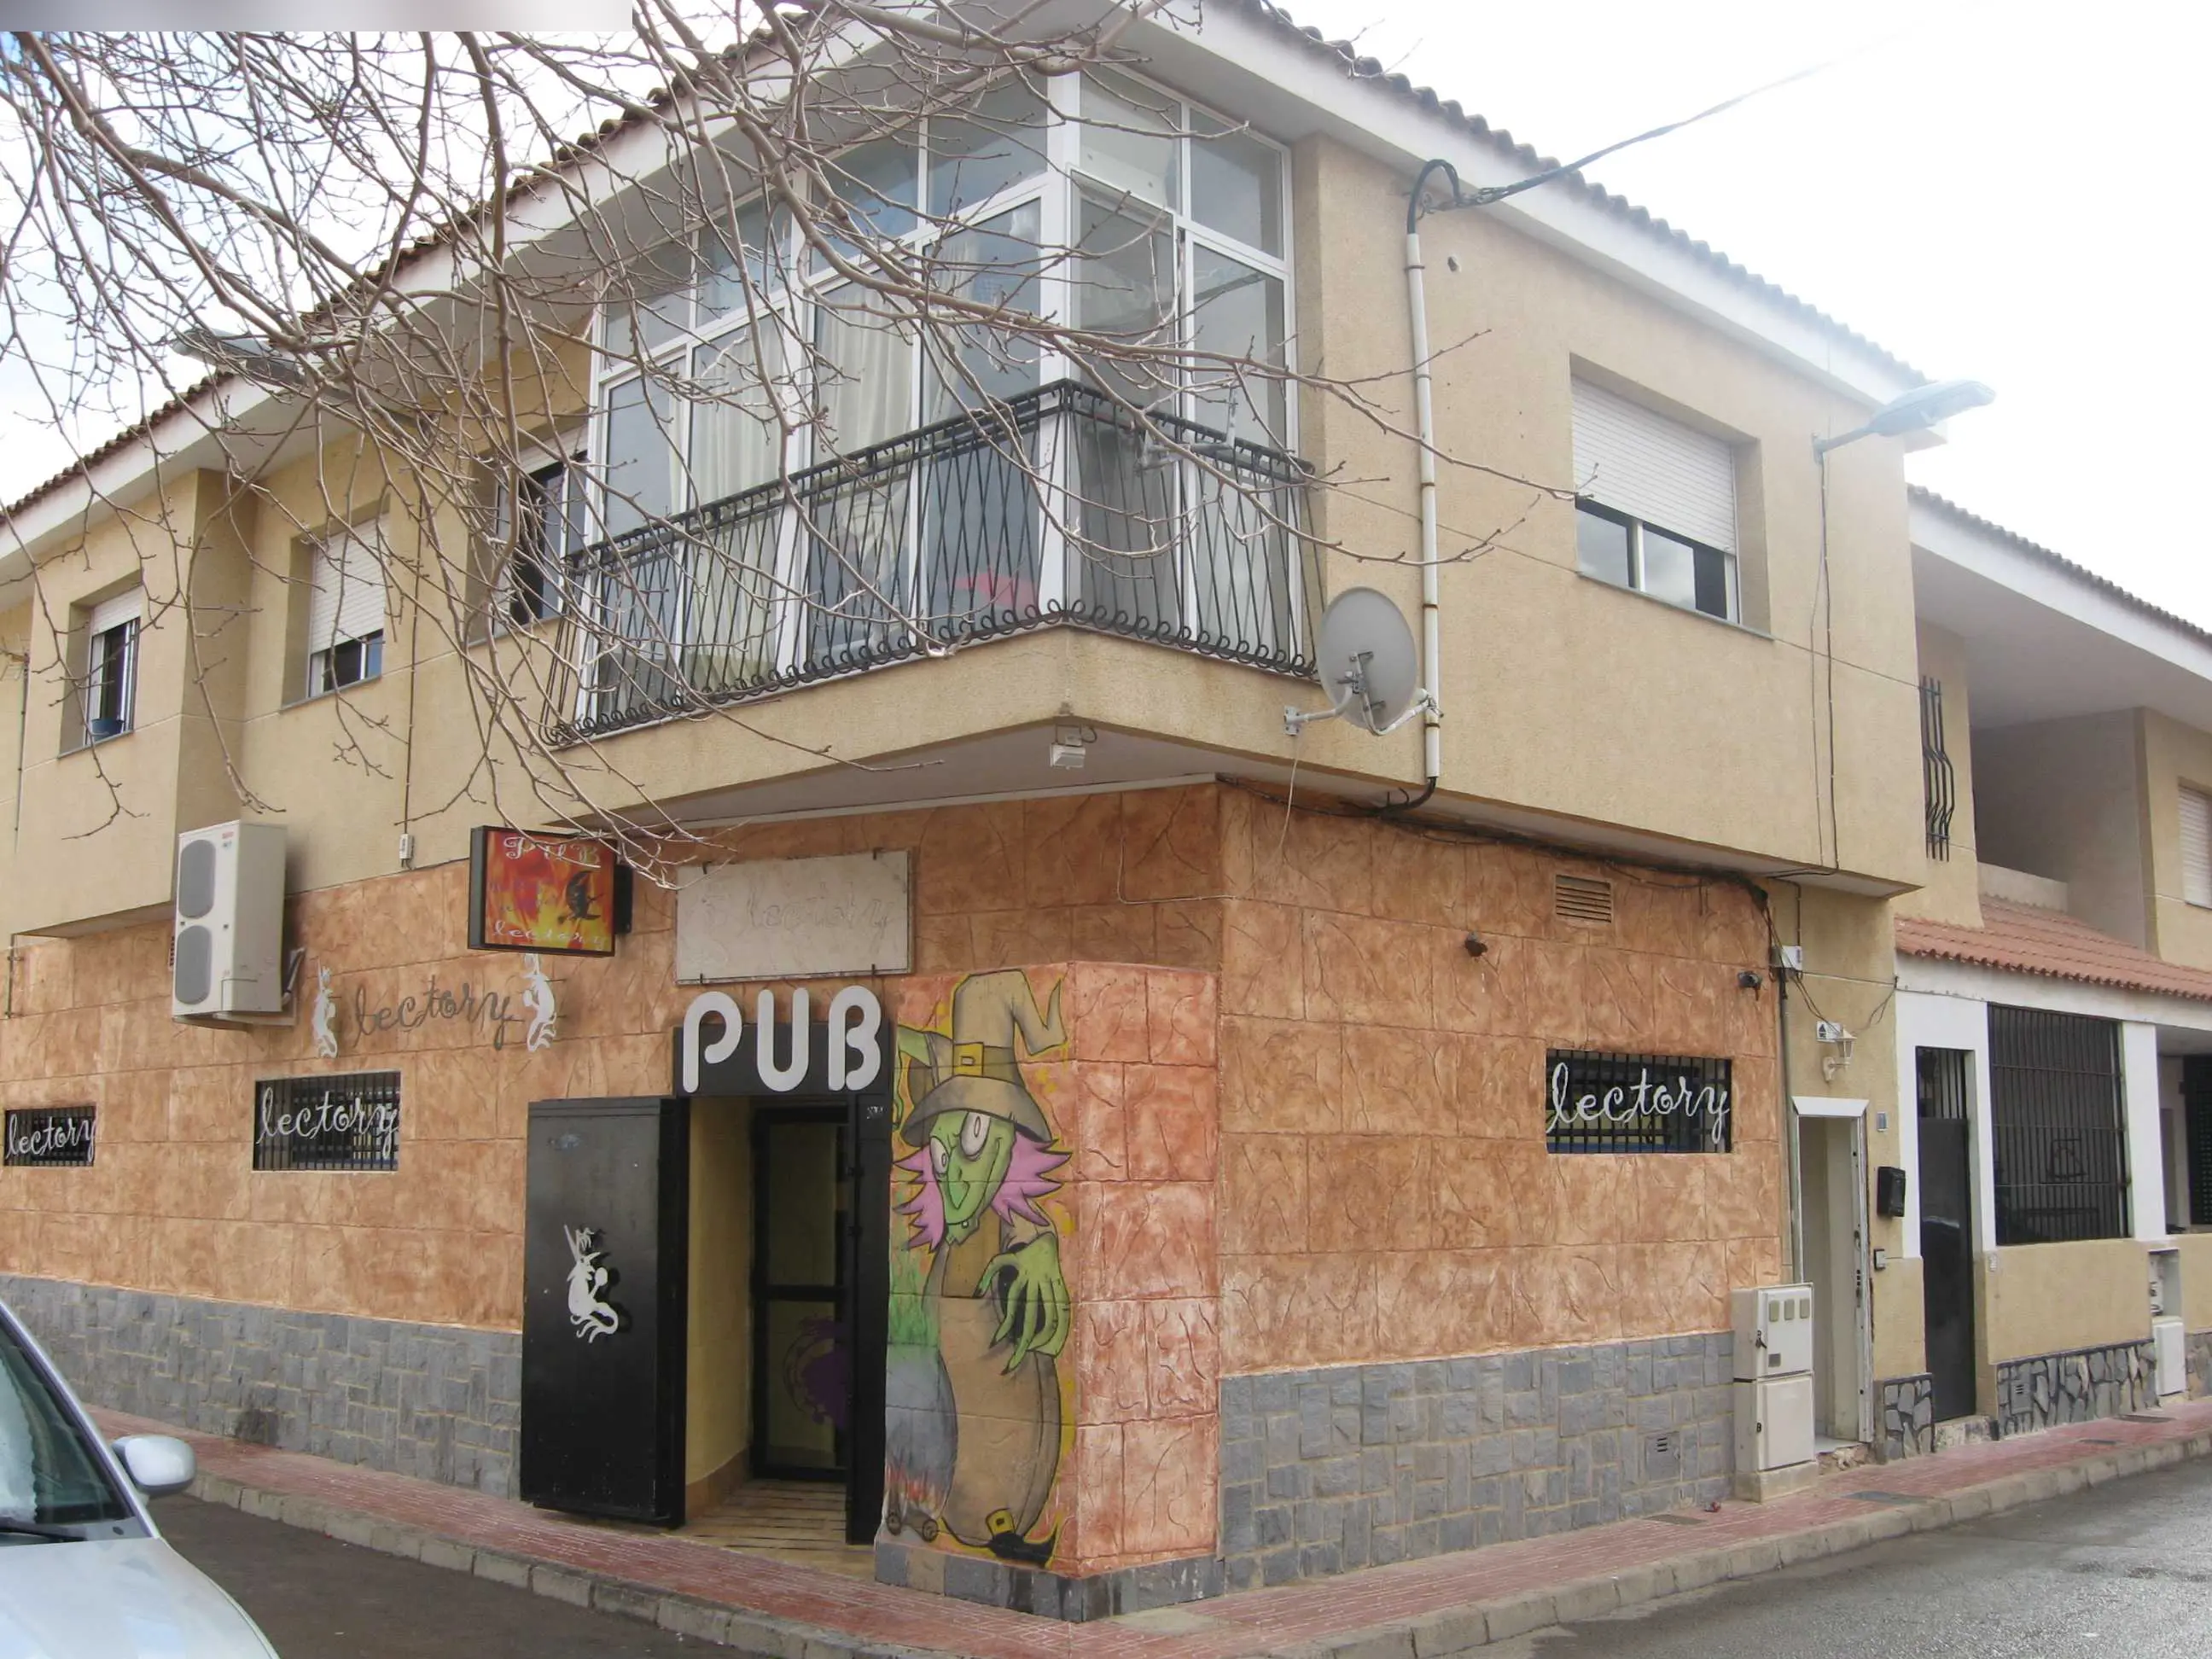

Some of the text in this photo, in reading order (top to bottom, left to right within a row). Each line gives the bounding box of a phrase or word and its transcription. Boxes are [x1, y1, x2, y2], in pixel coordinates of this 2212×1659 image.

[353, 975, 519, 1051] lectory
[683, 986, 882, 1092] PUB
[5, 1114, 96, 1162] lectory
[256, 1086, 399, 1158] lectory
[1545, 1062, 1730, 1144] lectory
